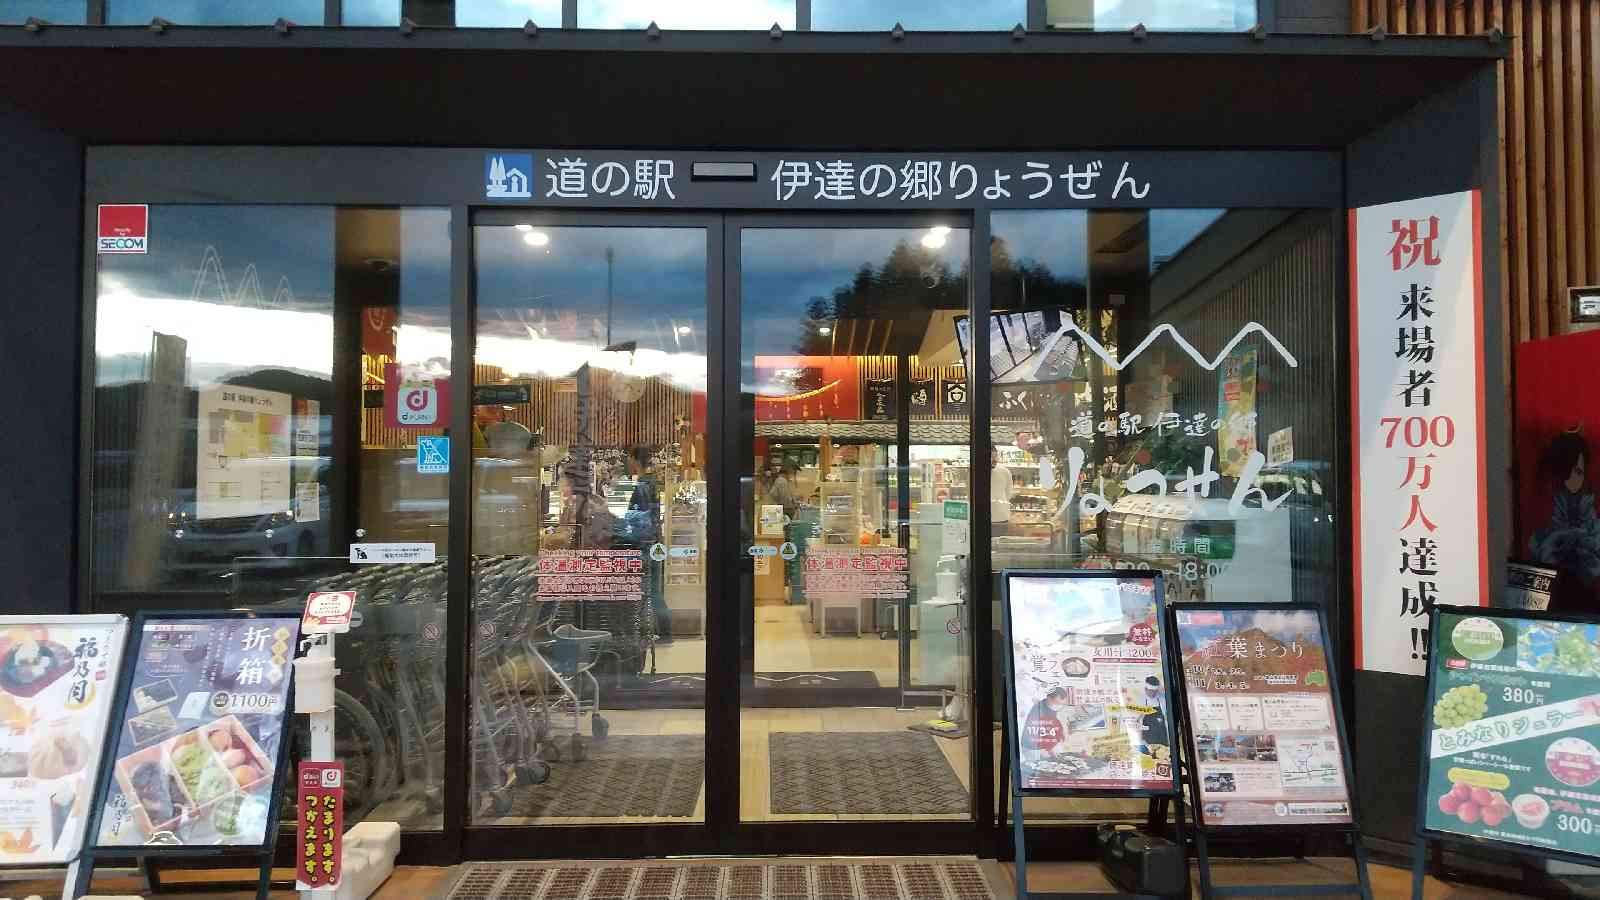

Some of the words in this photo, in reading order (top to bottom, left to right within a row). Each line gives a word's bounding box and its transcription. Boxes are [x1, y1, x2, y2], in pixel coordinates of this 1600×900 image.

[545, 158, 676, 200] 道の駅
[771, 159, 1151, 201] 伊達の郷りょうぜん
[101, 238, 145, 250] SECOM
[1388, 215, 1442, 271] 祝
[236, 626, 273, 685] 折箱
[322, 794, 338, 882] たまります。
